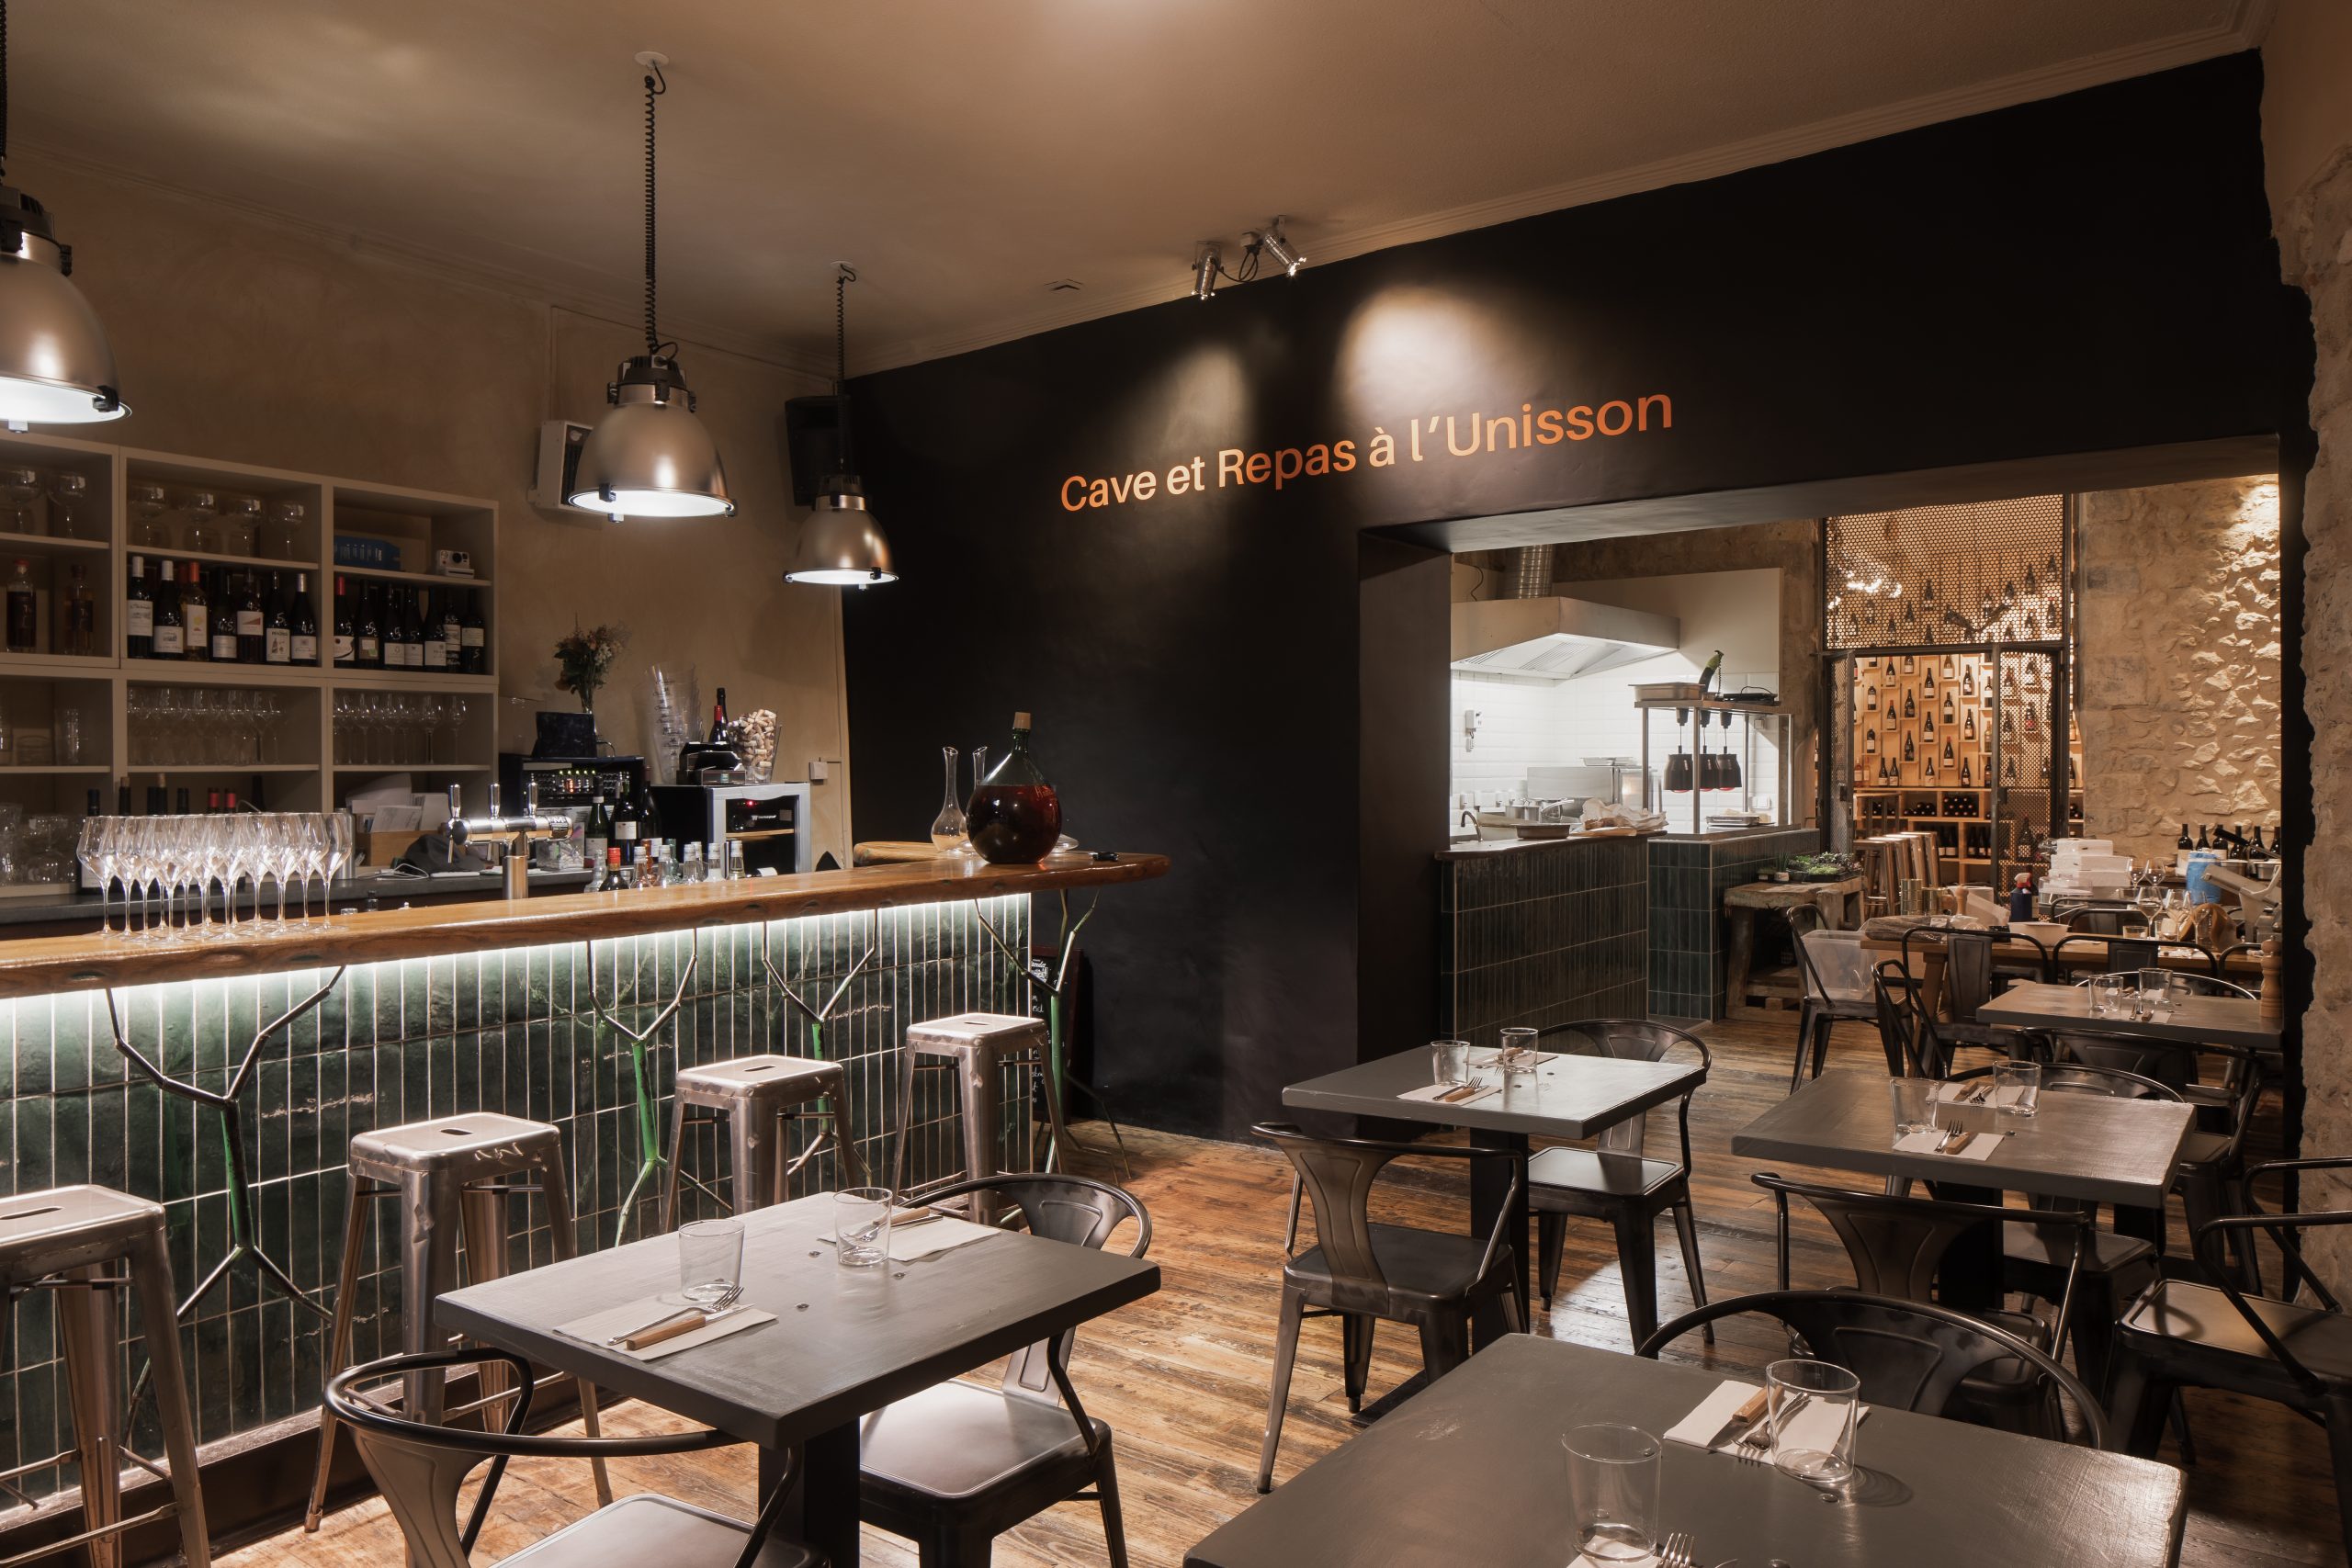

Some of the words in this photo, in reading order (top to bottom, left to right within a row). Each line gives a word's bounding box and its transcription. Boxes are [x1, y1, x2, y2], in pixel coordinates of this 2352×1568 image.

[1060, 468, 1157, 513] Cave
[1166, 456, 1205, 495] et
[1218, 437, 1357, 490] Repas
[1368, 426, 1396, 468] à
